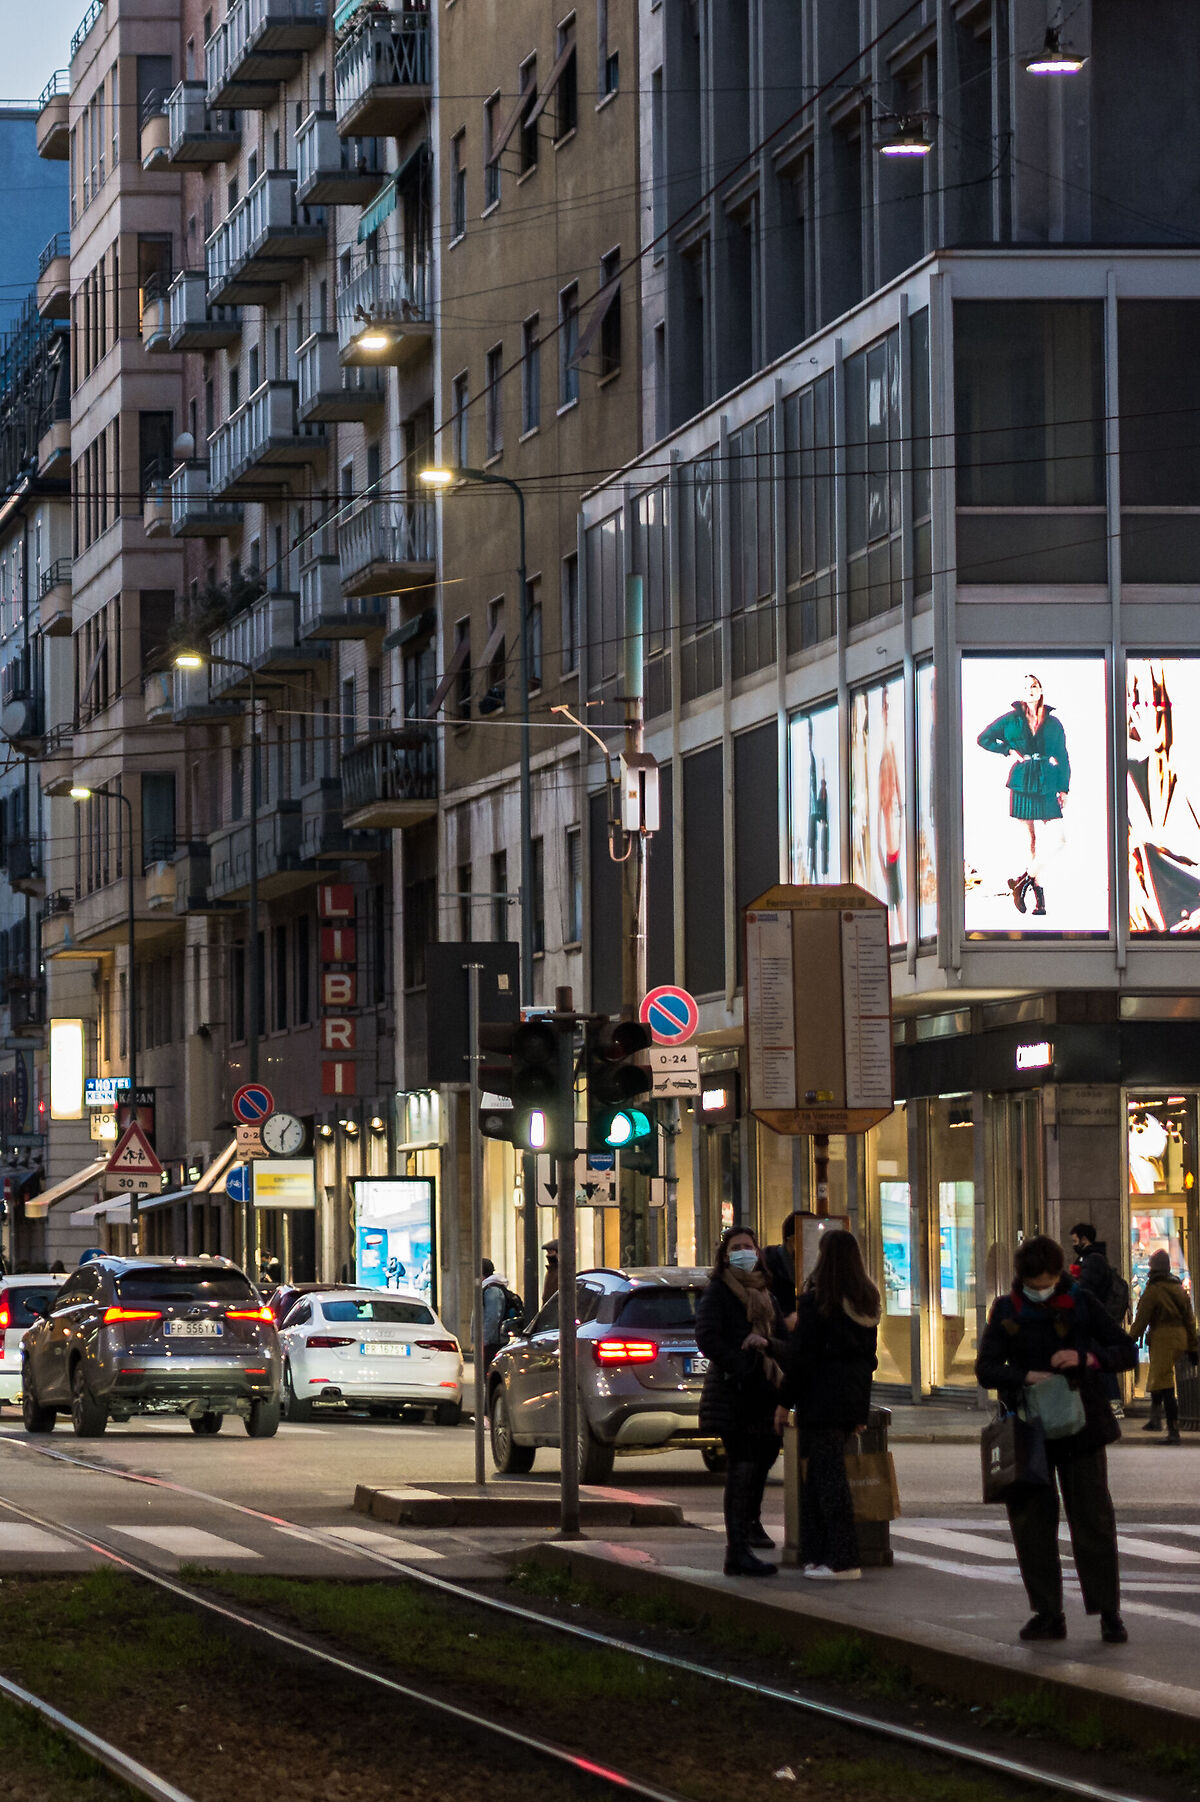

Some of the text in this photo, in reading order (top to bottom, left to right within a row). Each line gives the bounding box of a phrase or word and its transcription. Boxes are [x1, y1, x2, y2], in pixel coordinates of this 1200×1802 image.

[324, 886, 352, 1093] LIBRI
[660, 1055, 687, 1064] 0-24
[95, 1079, 130, 1091] HOTEL
[119, 1179, 134, 1188] 30
[170, 1323, 182, 1334] FP
[692, 1359, 708, 1372] FS
